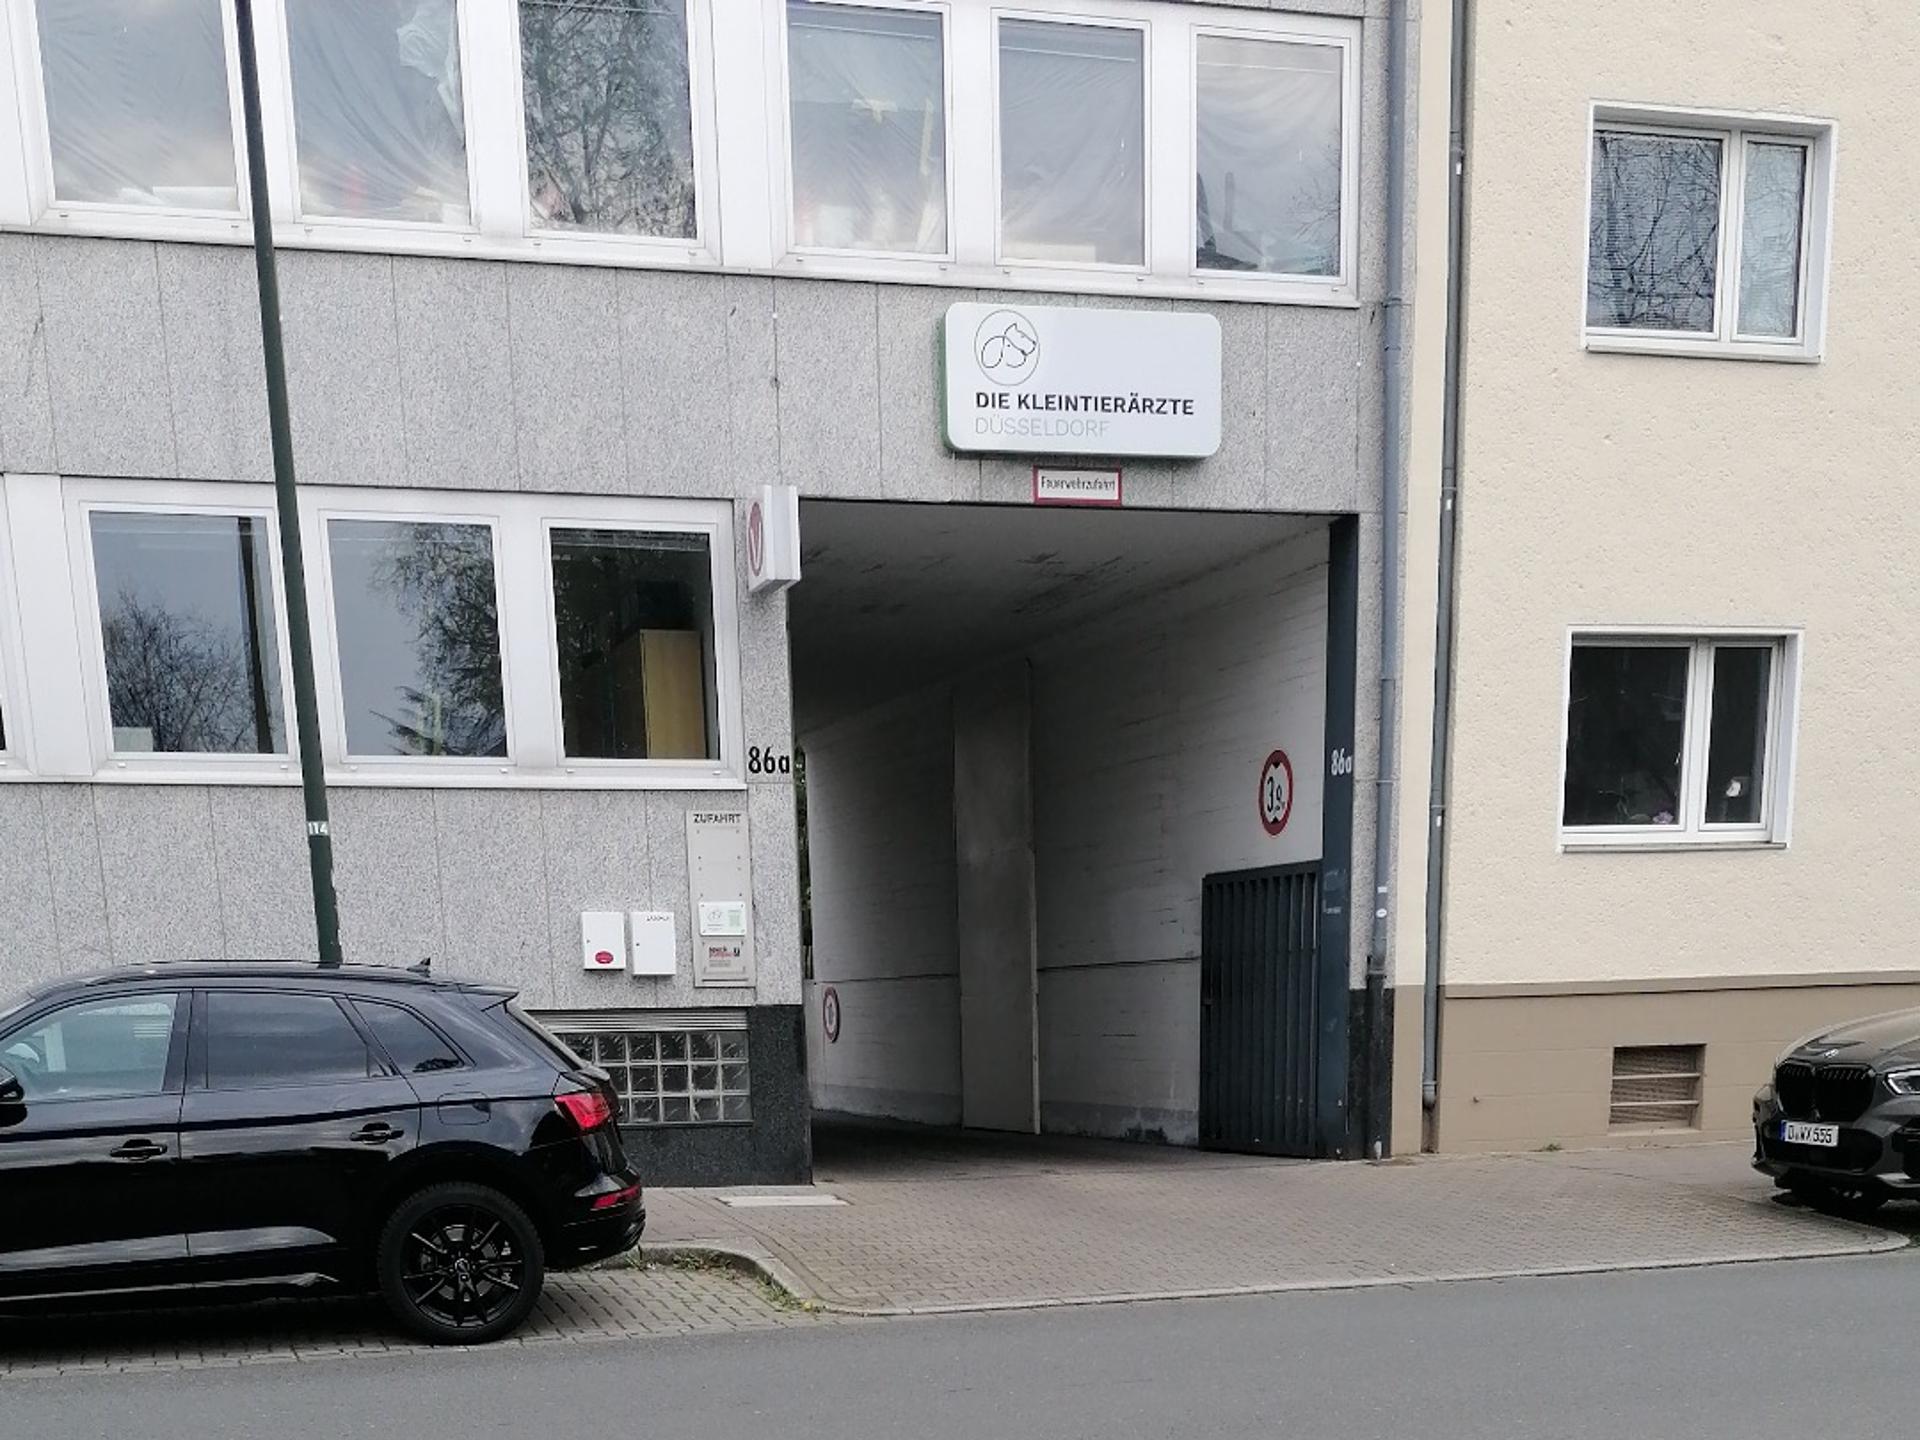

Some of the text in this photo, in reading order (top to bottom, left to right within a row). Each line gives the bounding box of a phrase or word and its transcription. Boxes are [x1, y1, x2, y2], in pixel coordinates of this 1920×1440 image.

[975, 392, 1195, 415] DIE KLEINTIERÄRZTE
[975, 414, 1111, 437] DÜSSELDORF
[749, 747, 790, 774] 86a
[1331, 748, 1353, 776] 86a
[693, 813, 742, 823] ZUFAHRT
